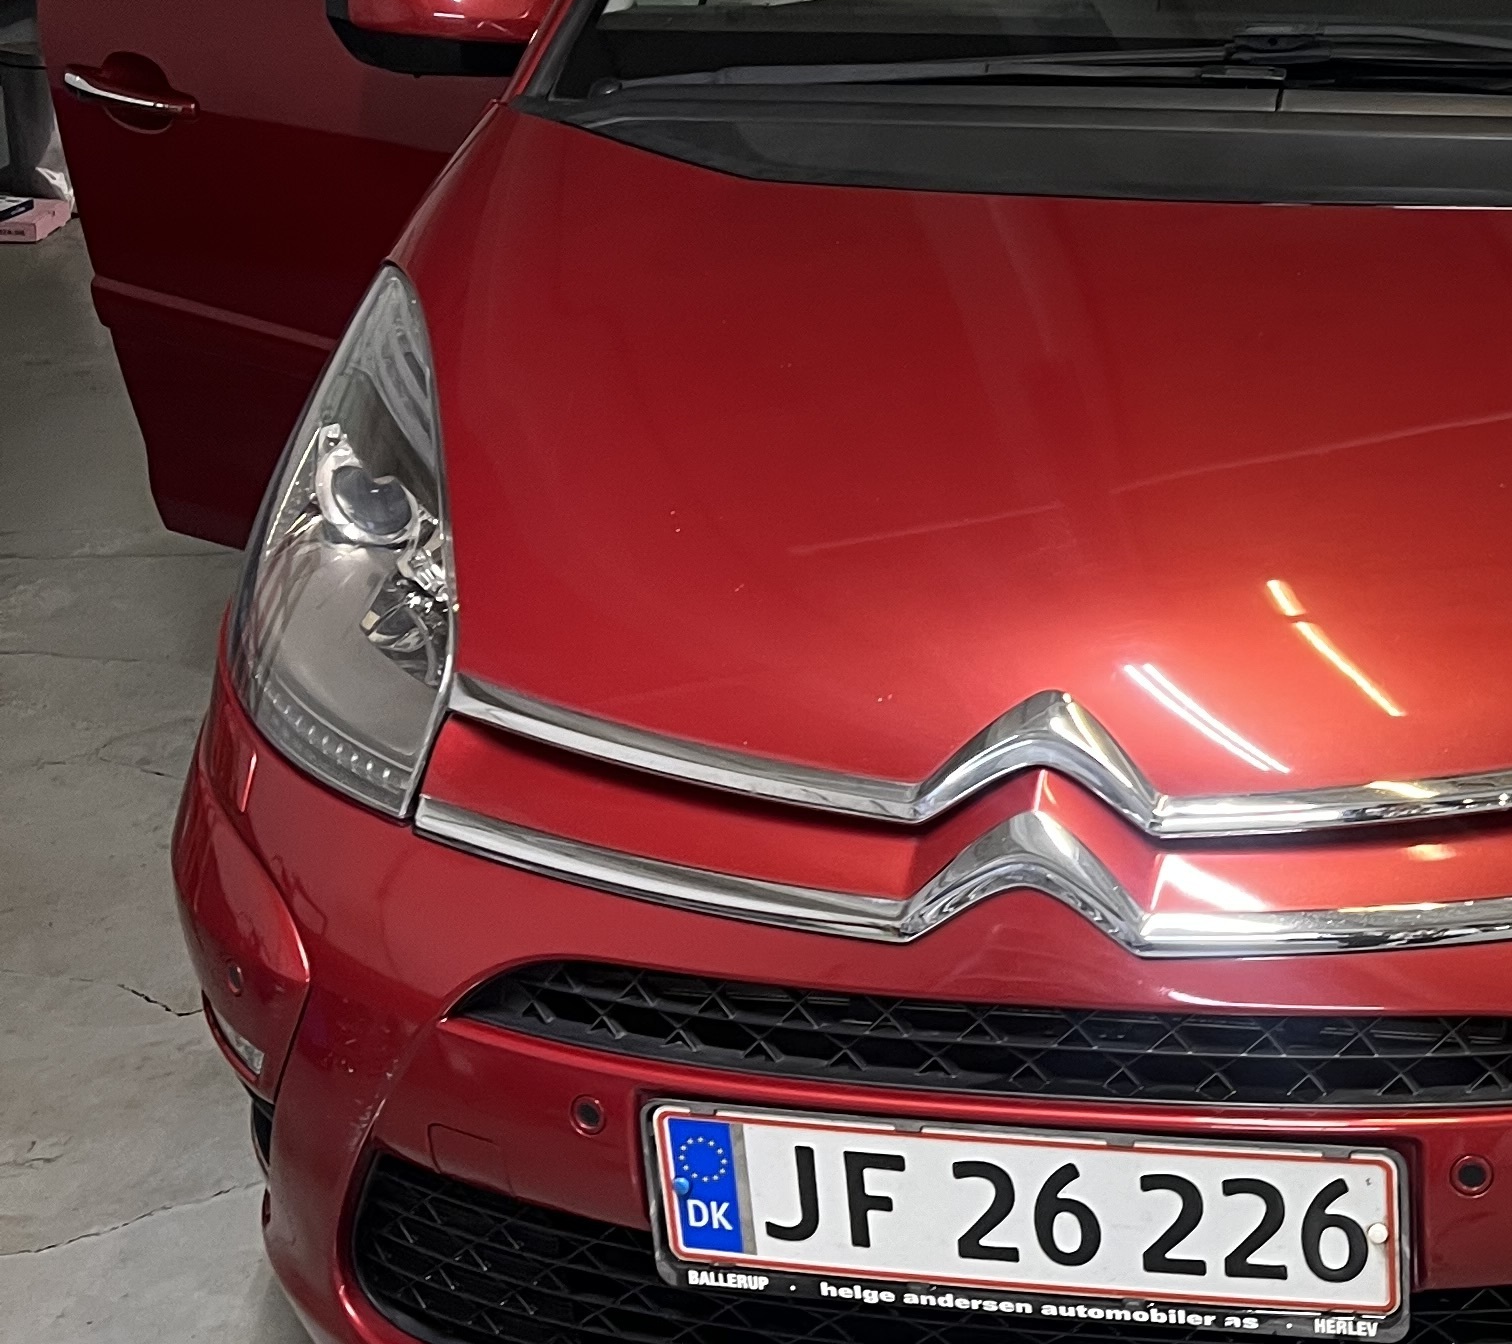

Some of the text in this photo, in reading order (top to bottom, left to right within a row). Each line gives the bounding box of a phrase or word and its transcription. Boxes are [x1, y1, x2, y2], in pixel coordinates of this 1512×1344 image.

[687, 1198, 733, 1230] DK
[765, 1144, 1369, 1283] JF 26 226
[688, 1269, 1379, 1338] BALLERUP helge andersen automobiler as HERLEV
